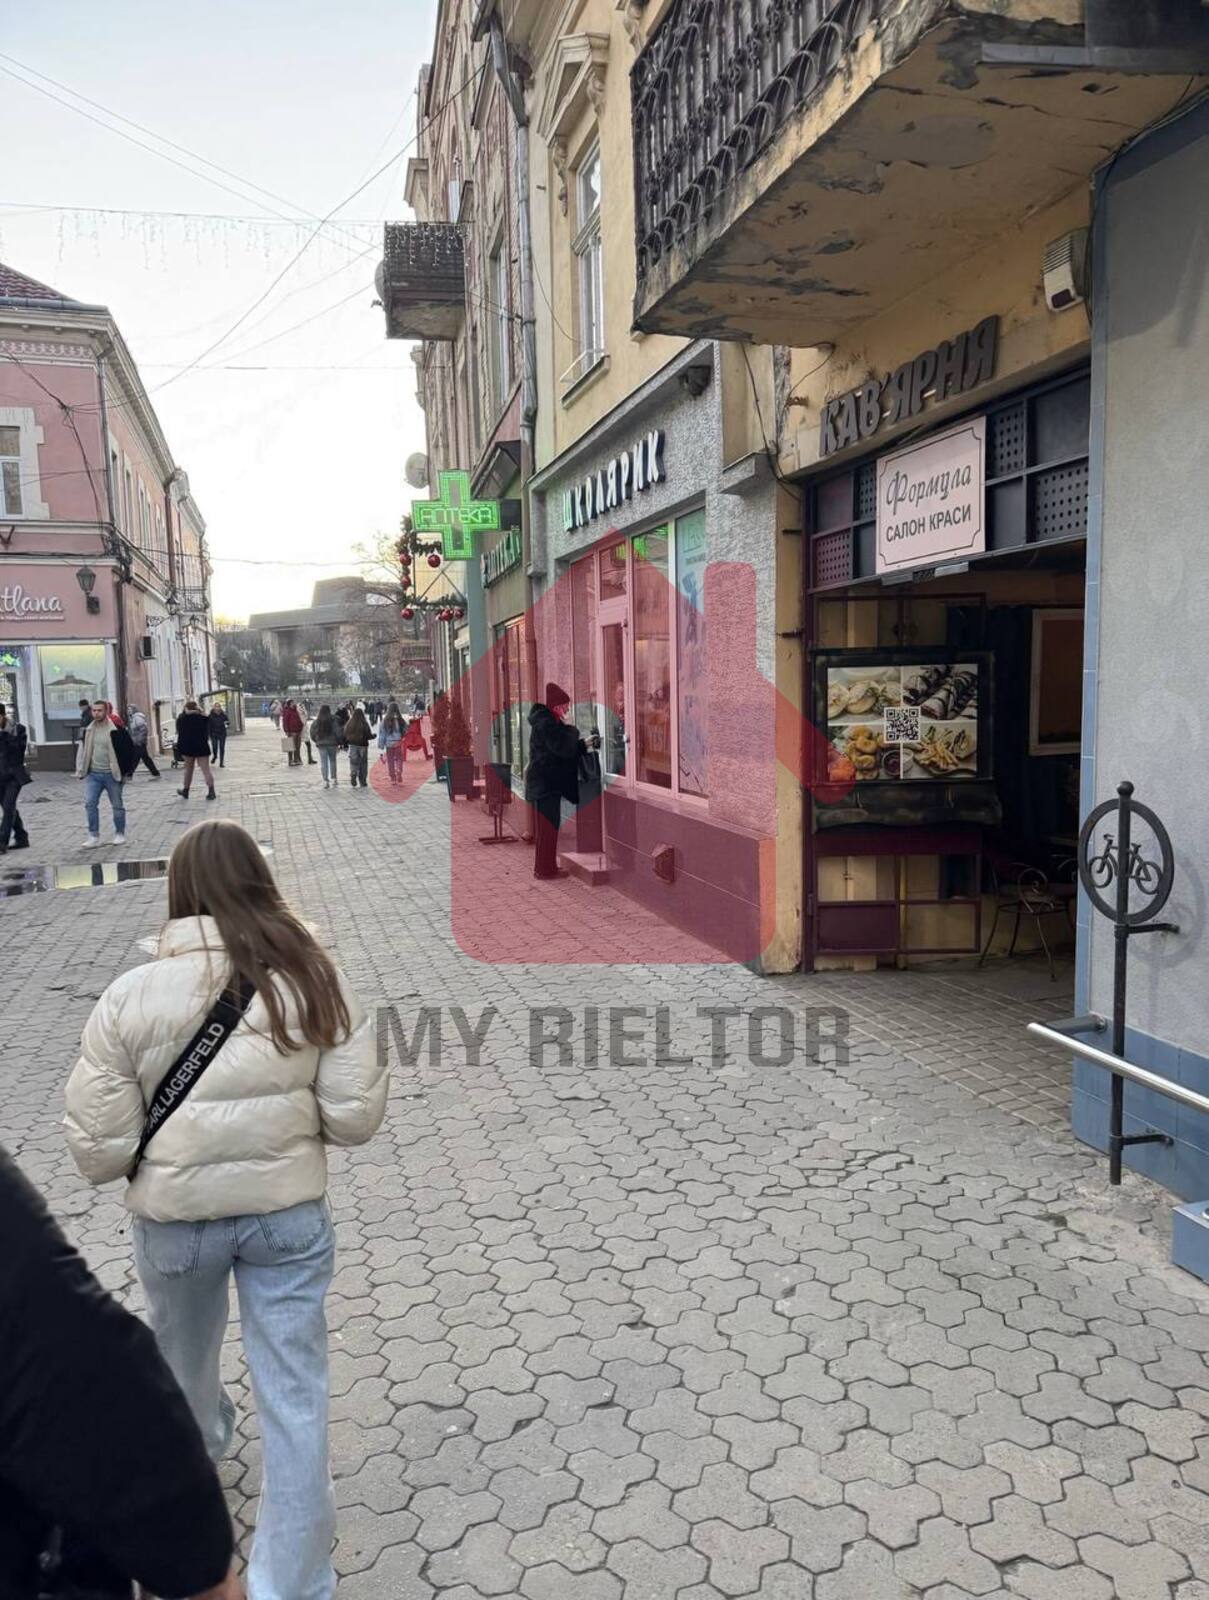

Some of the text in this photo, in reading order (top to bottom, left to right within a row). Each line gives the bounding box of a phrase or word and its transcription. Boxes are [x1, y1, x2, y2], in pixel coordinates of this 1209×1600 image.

[819, 314, 1000, 458] КАВ'ЯРНЯ
[563, 429, 666, 533] ШКОЛЯРИК
[886, 464, 973, 516] Формула
[420, 507, 492, 523] АПТЕКА
[886, 503, 972, 543] САЛОН КРАСИ
[0, 585, 63, 616] tlana
[147, 1022, 224, 1131] ARL LAGERFELD
